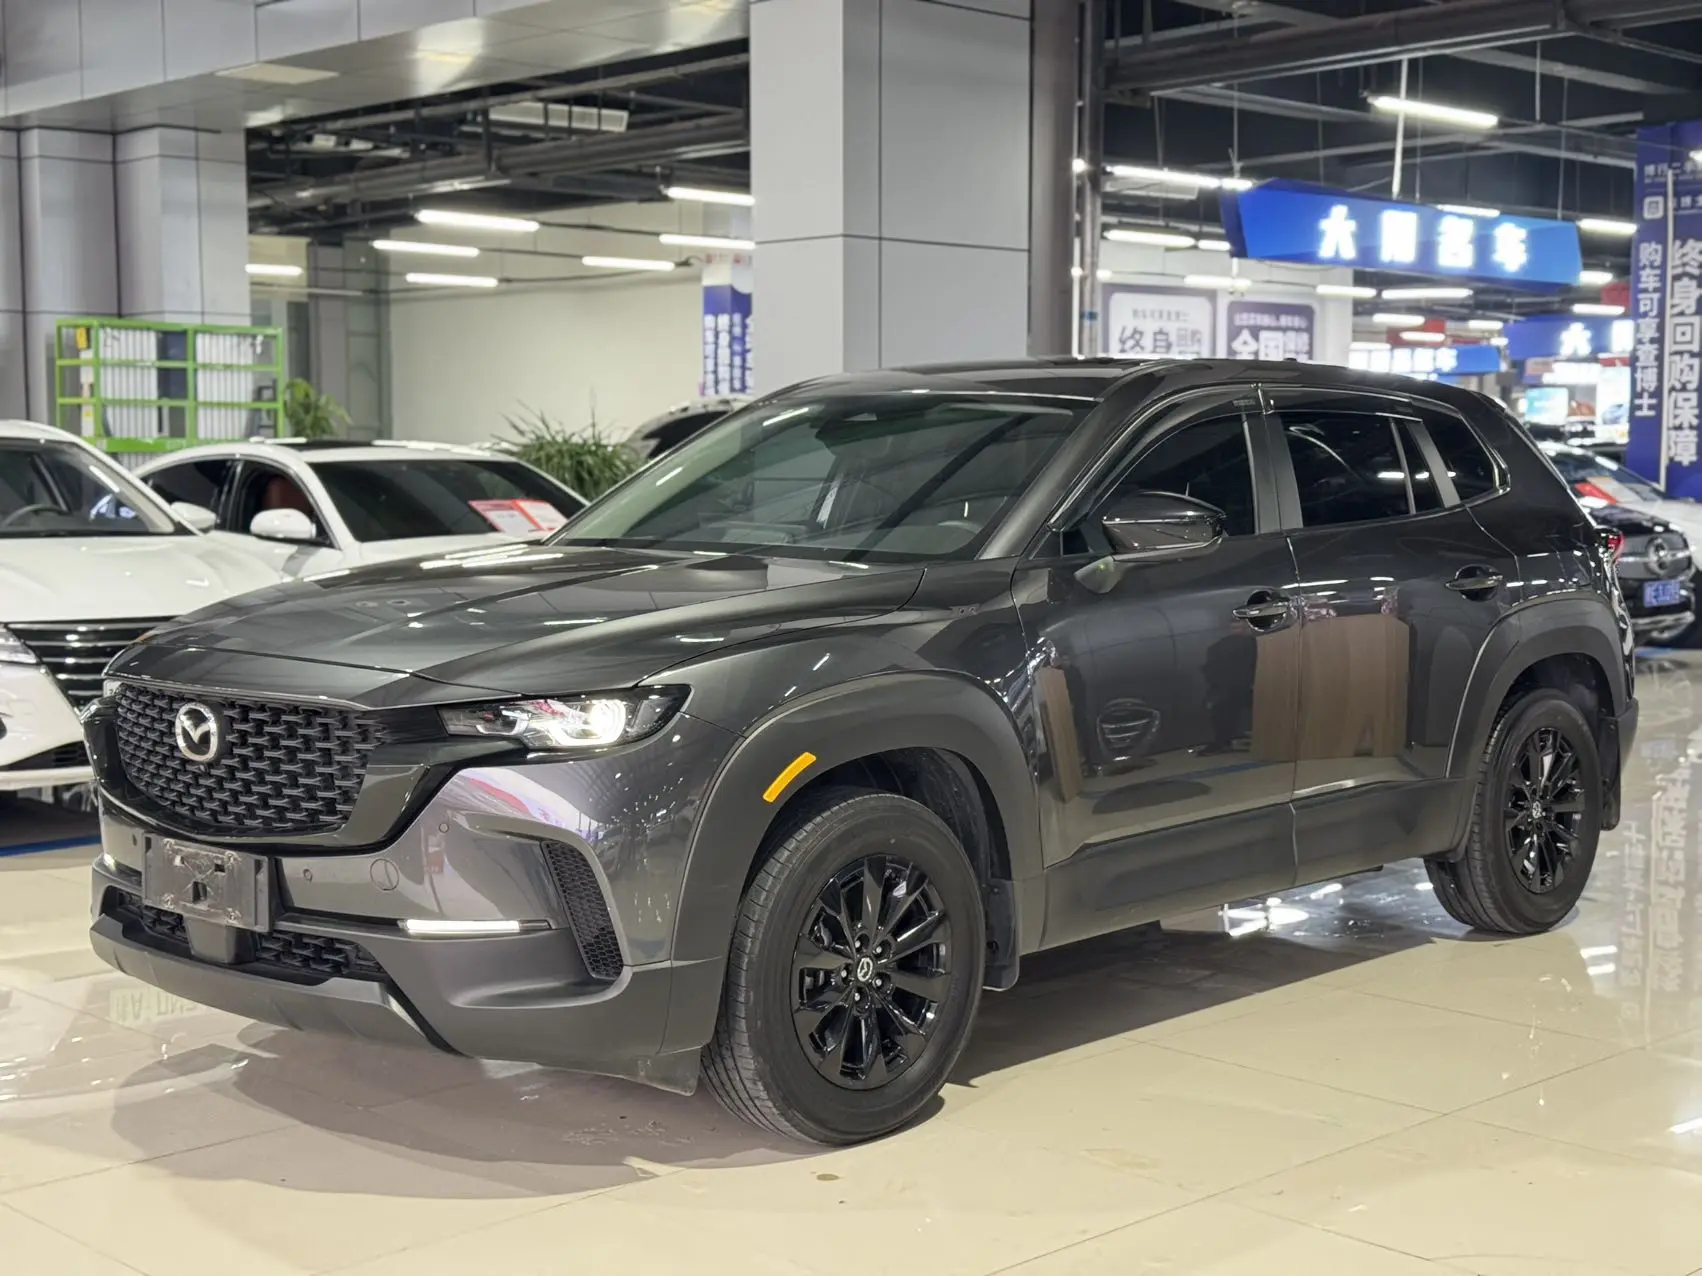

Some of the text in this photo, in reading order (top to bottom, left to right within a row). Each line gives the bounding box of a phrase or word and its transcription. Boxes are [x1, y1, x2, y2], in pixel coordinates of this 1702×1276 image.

[1635, 241, 1663, 417] 购车可享查博士
[1669, 238, 1702, 467] 终身回购保障
